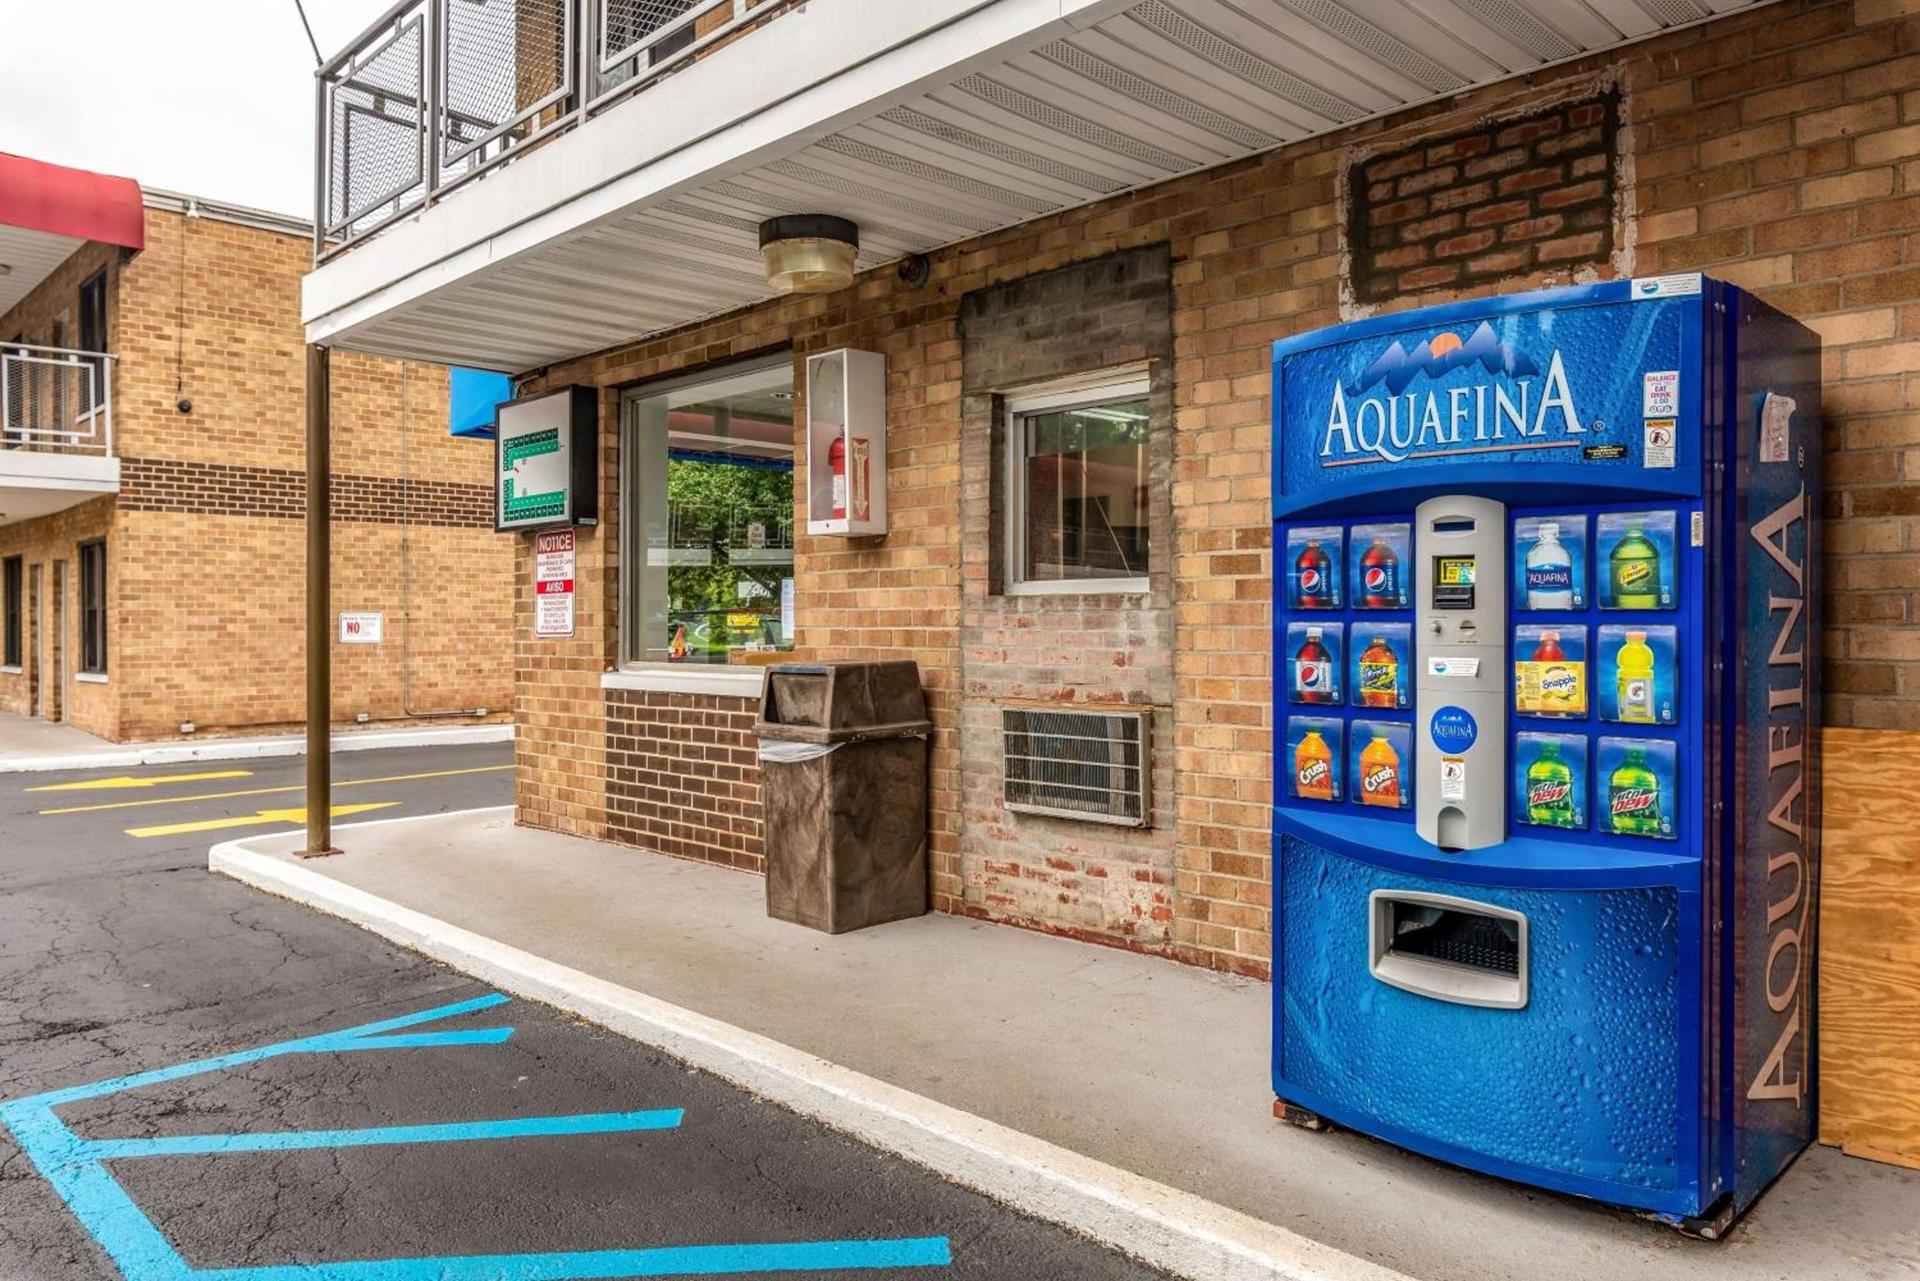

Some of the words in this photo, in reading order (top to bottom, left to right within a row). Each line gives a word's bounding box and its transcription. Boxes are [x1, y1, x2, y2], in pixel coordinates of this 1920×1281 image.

[1320, 349, 1587, 462] AQUAFINA
[539, 534, 572, 552] NOTICE
[346, 622, 360, 634] NO
[1542, 674, 1577, 690] Snapple
[1433, 720, 1472, 738] AQUAFINA
[1300, 759, 1328, 785] Crush
[1364, 766, 1395, 792] Crush
[1746, 486, 1810, 1108] AQUAFINA
